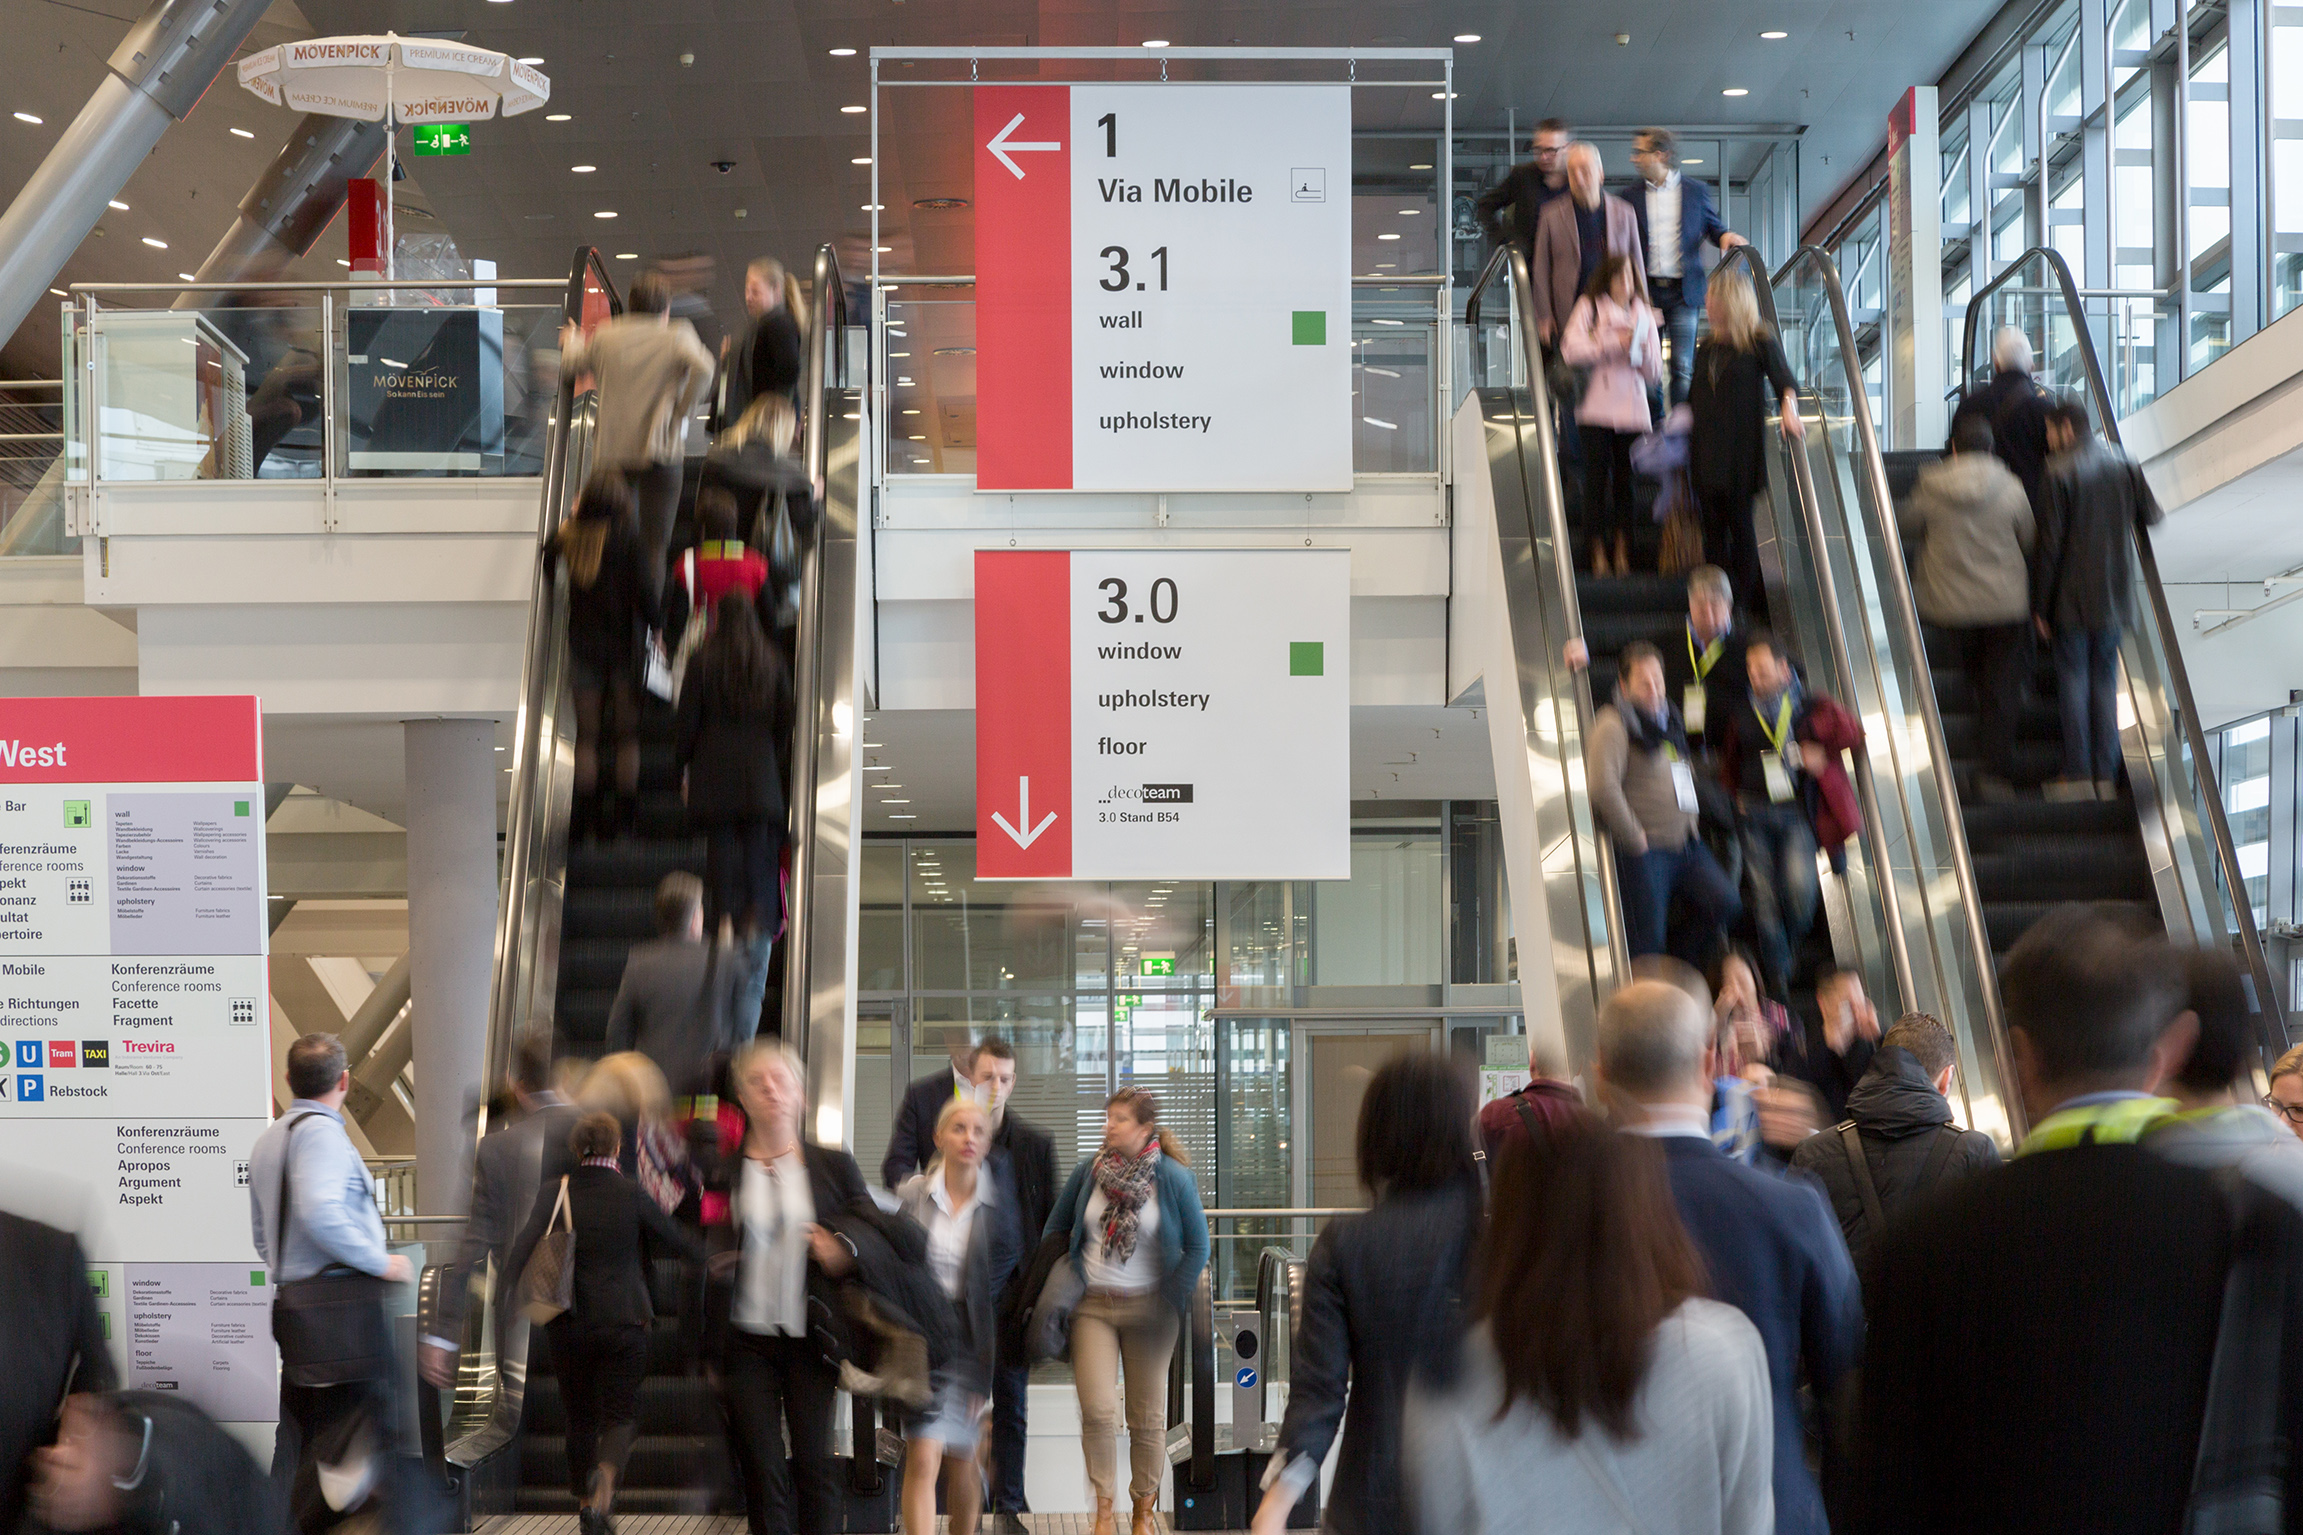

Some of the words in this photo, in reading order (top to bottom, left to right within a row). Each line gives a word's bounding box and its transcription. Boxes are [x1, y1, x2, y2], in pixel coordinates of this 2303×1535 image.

[294, 43, 380, 60] MÖVENPICK
[409, 49, 450, 60] PREMIUM
[452, 52, 465, 62] ICE
[467, 54, 497, 66] CREAM
[1098, 113, 1116, 158] 1
[1098, 178, 1142, 203] Via
[1154, 178, 1253, 203] Mobile
[1099, 245, 1168, 292] 3.1
[1099, 310, 1142, 329] wall
[1099, 360, 1185, 379] window
[373, 373, 458, 388] MÖVENPICK
[1100, 411, 1212, 434] upholstery
[1097, 577, 1179, 624] 3.0
[1098, 641, 1182, 660] window
[1098, 689, 1211, 712] upholstery
[1098, 737, 1147, 755] floor
[0, 739, 67, 768] West
[6, 800, 26, 812] Bar
[1099, 812, 1116, 823] 3.0
[1120, 812, 1153, 823] Stand
[1157, 812, 1179, 823] B54
[46, 862, 84, 871] rooms
[117, 898, 155, 906] upholstery
[0, 928, 43, 940] ertoire
[2, 964, 46, 976] Mobile
[111, 963, 215, 975] Konferenzräume
[112, 980, 180, 992] Conference
[184, 983, 222, 992] rooms
[8, 998, 80, 1012] Richtungen
[112, 998, 159, 1009] Facette
[0, 1015, 58, 1027] directions
[113, 1014, 173, 1029] Fragment
[51, 1049, 74, 1058] Tram
[122, 1040, 175, 1053] Trevira
[22, 1045, 37, 1063] U
[84, 1049, 107, 1059] TAXI
[24, 1079, 37, 1097] P
[50, 1086, 108, 1097] Rebstock
[117, 1126, 220, 1137] Konferenzräume
[117, 1142, 185, 1154] Conference
[189, 1145, 227, 1154] rooms
[118, 1160, 171, 1173] Apropos
[118, 1176, 181, 1190] Argument
[119, 1193, 163, 1207] Aspekt
[134, 1312, 172, 1320] upholstery
